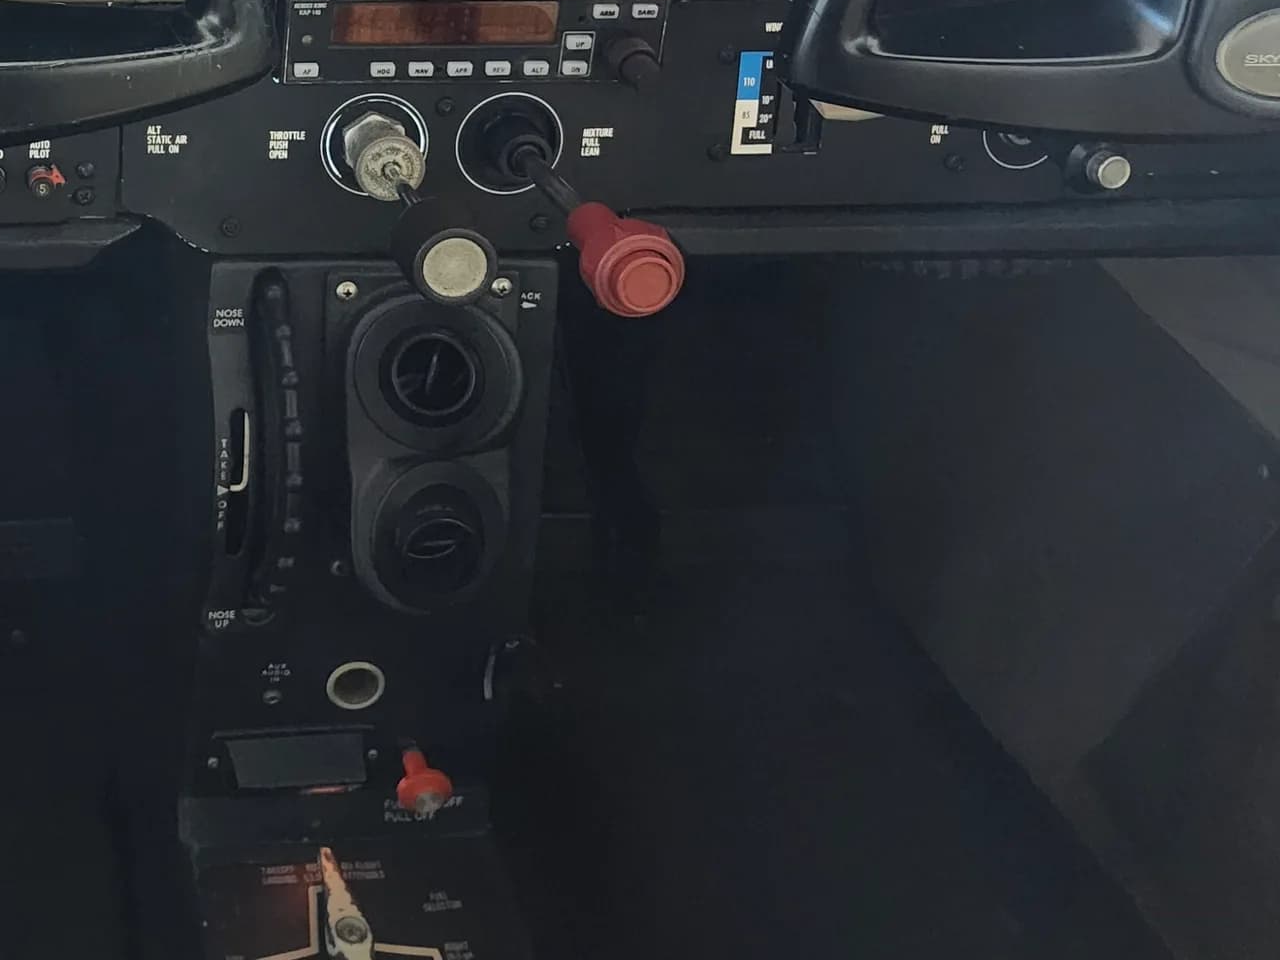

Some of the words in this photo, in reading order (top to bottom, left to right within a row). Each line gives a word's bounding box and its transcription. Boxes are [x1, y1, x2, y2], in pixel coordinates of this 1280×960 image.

[743, 77, 756, 87] 110
[147, 125, 162, 135] ALT
[582, 128, 613, 137] MIXTURE
[749, 129, 766, 140] FULL
[147, 135, 172, 144] STATIC
[174, 135, 187, 144] AIR
[269, 131, 305, 140] THROTTLE
[269, 141, 288, 149] PUSH
[581, 138, 600, 147] PULL
[147, 145, 165, 153] PULL
[169, 145, 180, 153] ON
[581, 147, 600, 156] LEAN
[269, 150, 287, 159] OPEN
[216, 309, 243, 318] NOSE
[213, 318, 244, 327] DOWN
[208, 611, 236, 620] NOSE
[215, 619, 230, 628] UP
